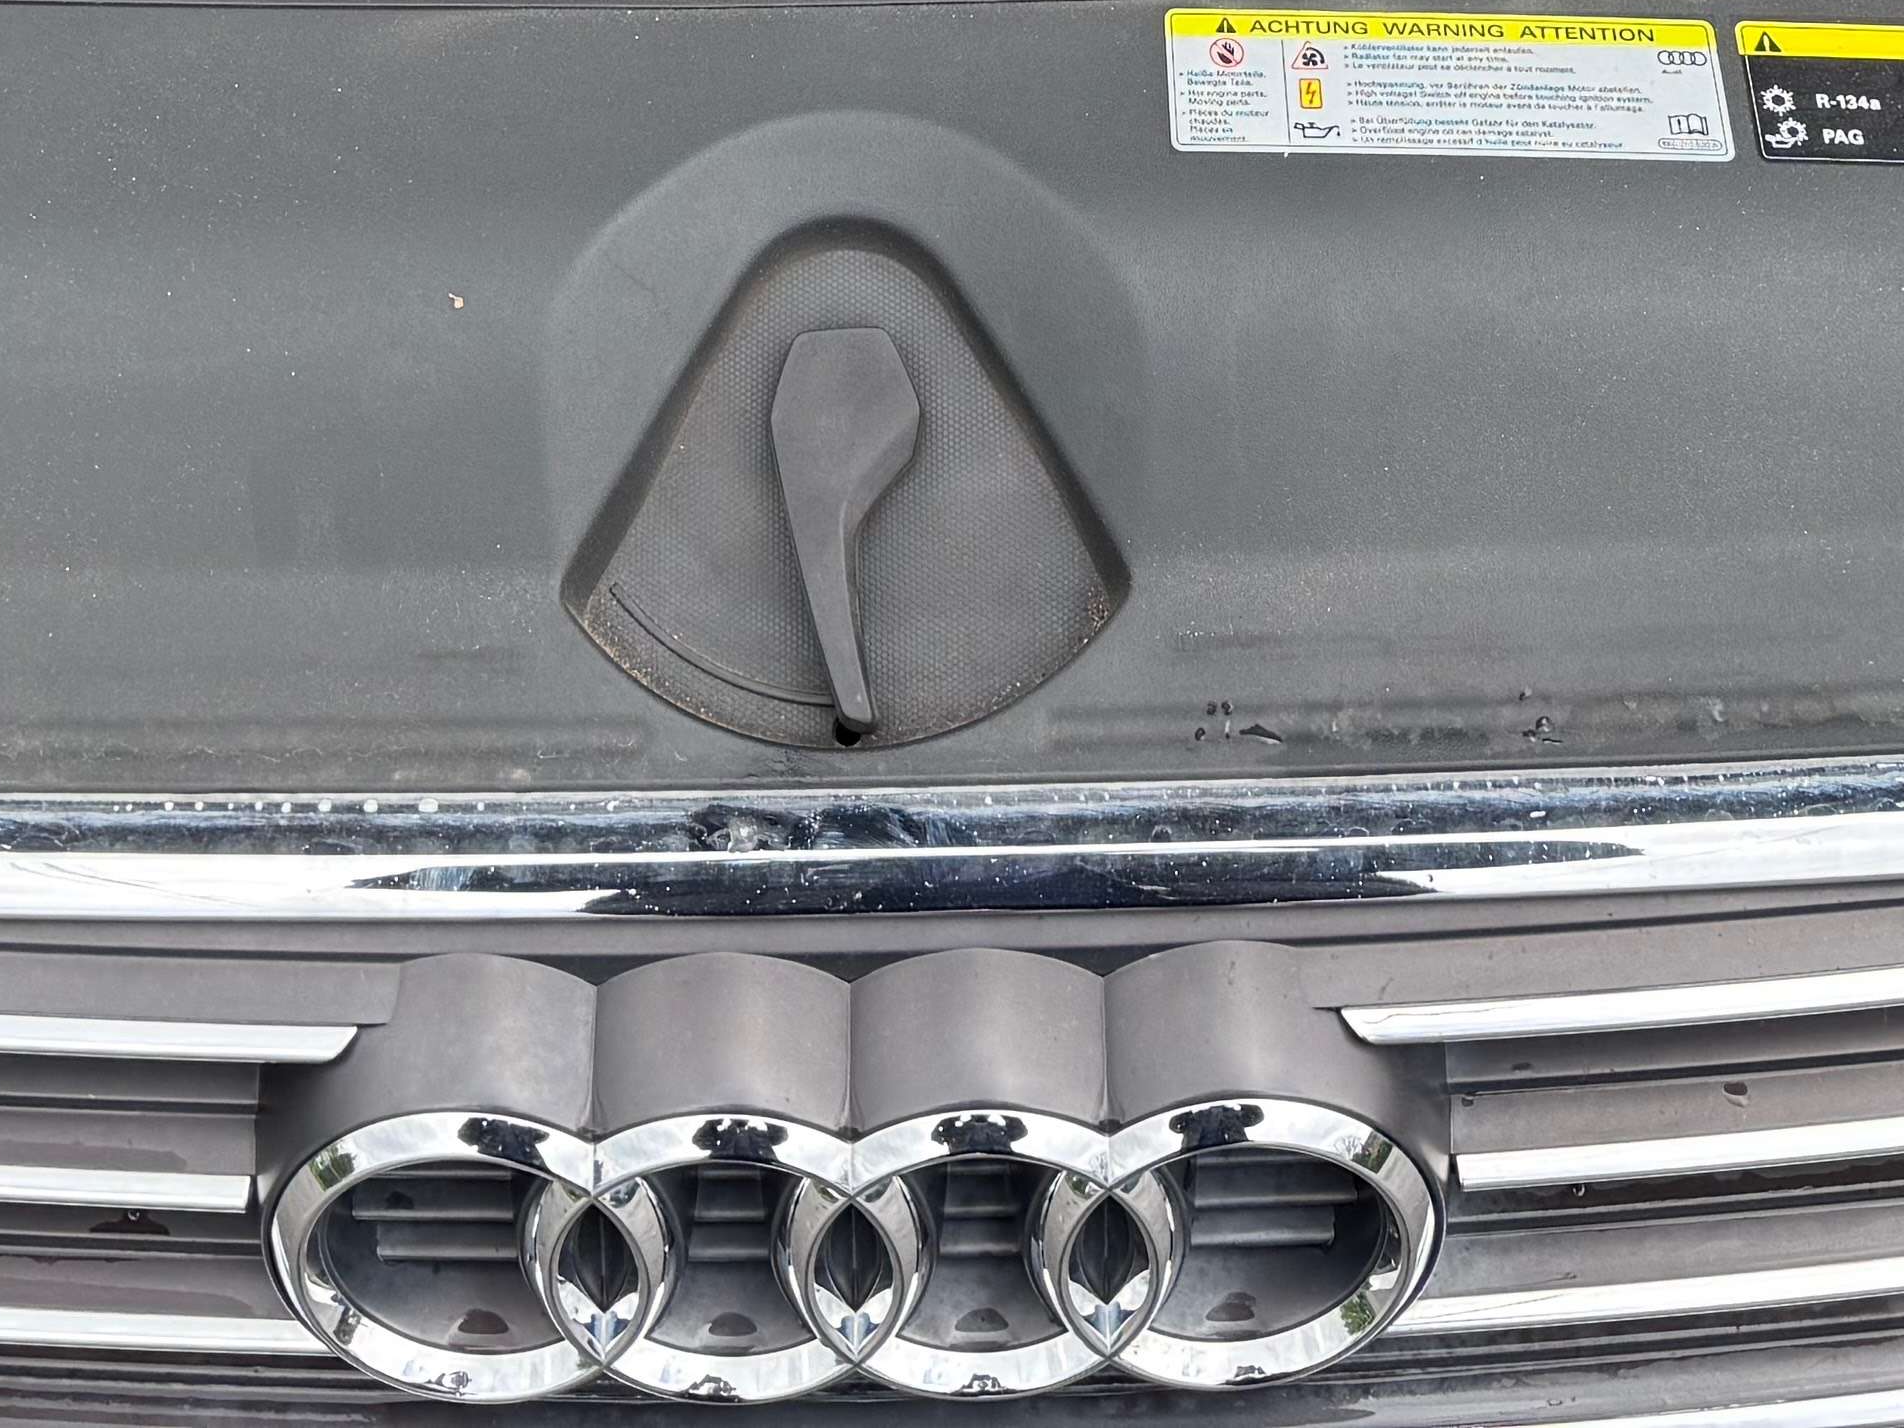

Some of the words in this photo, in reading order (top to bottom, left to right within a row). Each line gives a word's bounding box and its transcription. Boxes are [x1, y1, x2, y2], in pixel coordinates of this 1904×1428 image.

[1249, 19, 1368, 35] ACHTUNG
[1383, 22, 1504, 38] WARNING
[1520, 25, 1654, 42] ATTENTION
[1815, 94, 1881, 111] R-134a
[1821, 128, 1865, 145] PAG
